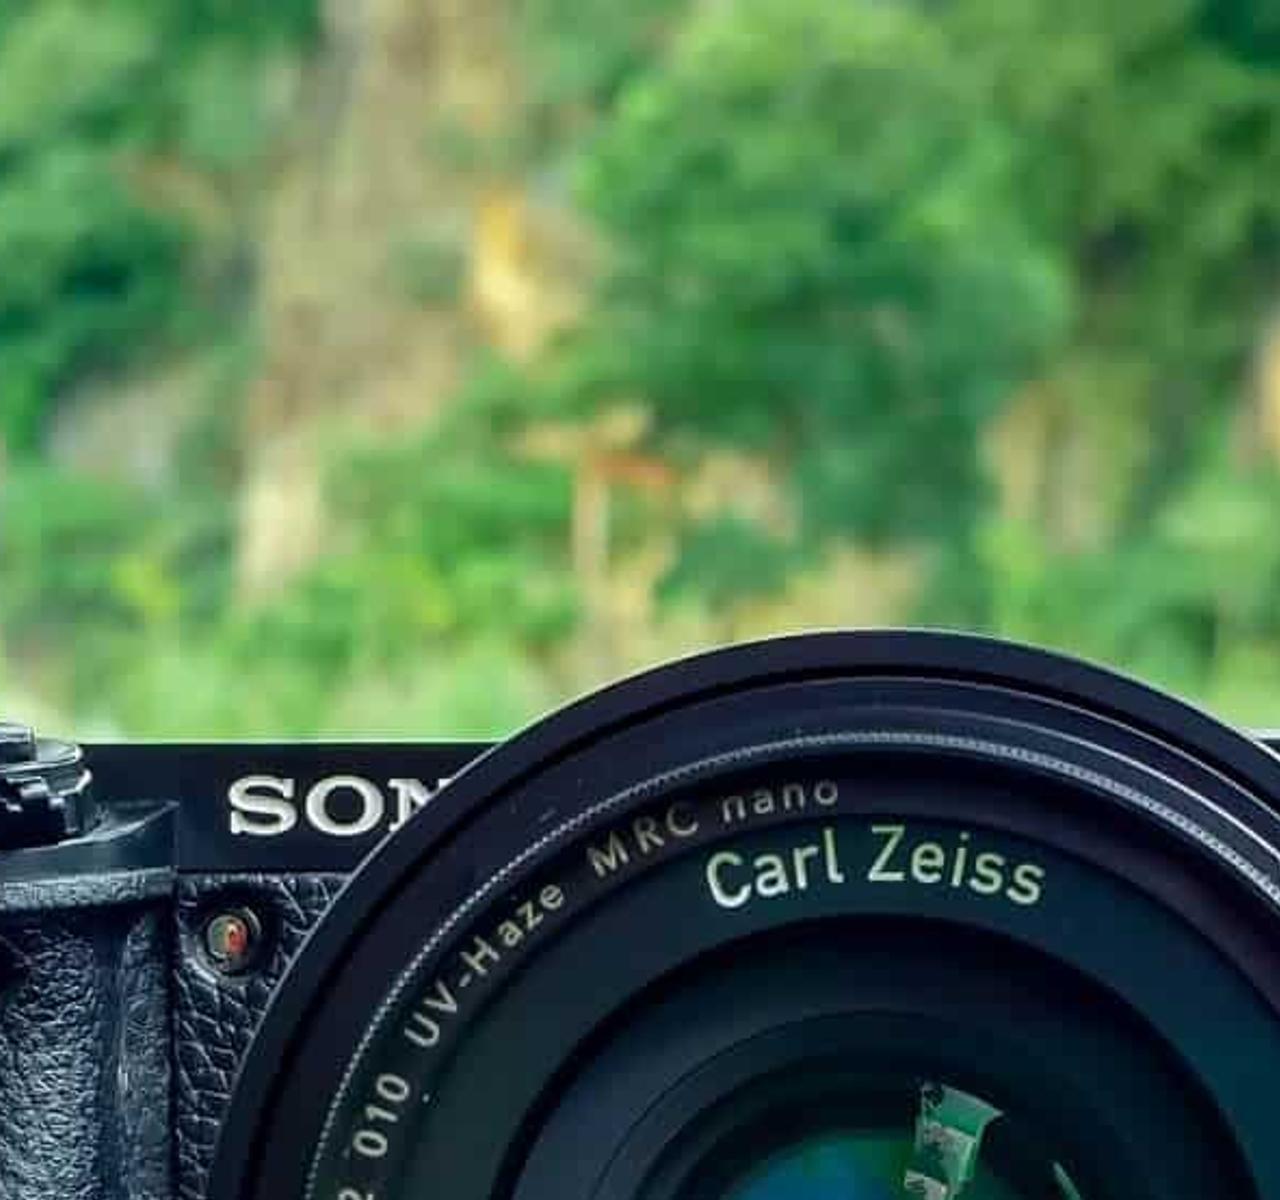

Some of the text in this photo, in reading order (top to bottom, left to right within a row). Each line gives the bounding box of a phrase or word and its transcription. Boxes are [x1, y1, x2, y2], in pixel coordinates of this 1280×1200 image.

[227, 774, 454, 837] SON
[706, 825, 1045, 908] Carl Zeiss
[352, 1073, 410, 1159] 010
[404, 882, 564, 1048] UV-Haze
[587, 808, 700, 878] MRC
[722, 778, 838, 823] nano
